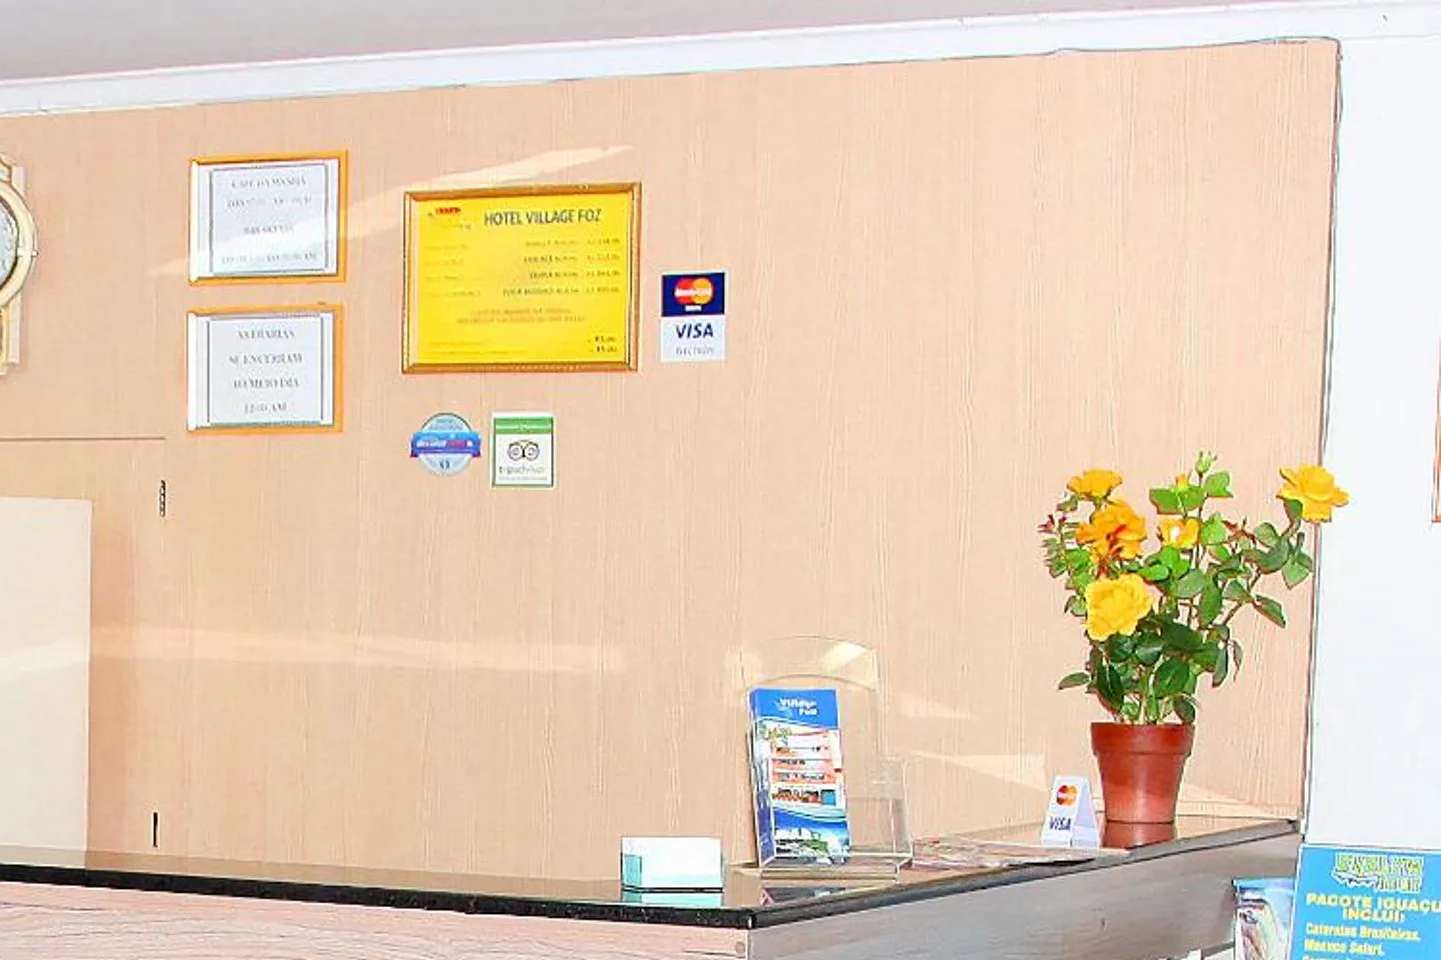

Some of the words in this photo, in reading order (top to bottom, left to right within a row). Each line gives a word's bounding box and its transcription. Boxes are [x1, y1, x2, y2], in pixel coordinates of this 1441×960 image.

[483, 210, 523, 227] HOTEL
[525, 208, 576, 225] VILLAGE
[577, 207, 603, 223] FOZ
[675, 322, 714, 340] VISA
[1049, 816, 1071, 831] VISA
[1306, 893, 1373, 908] PACOTE
